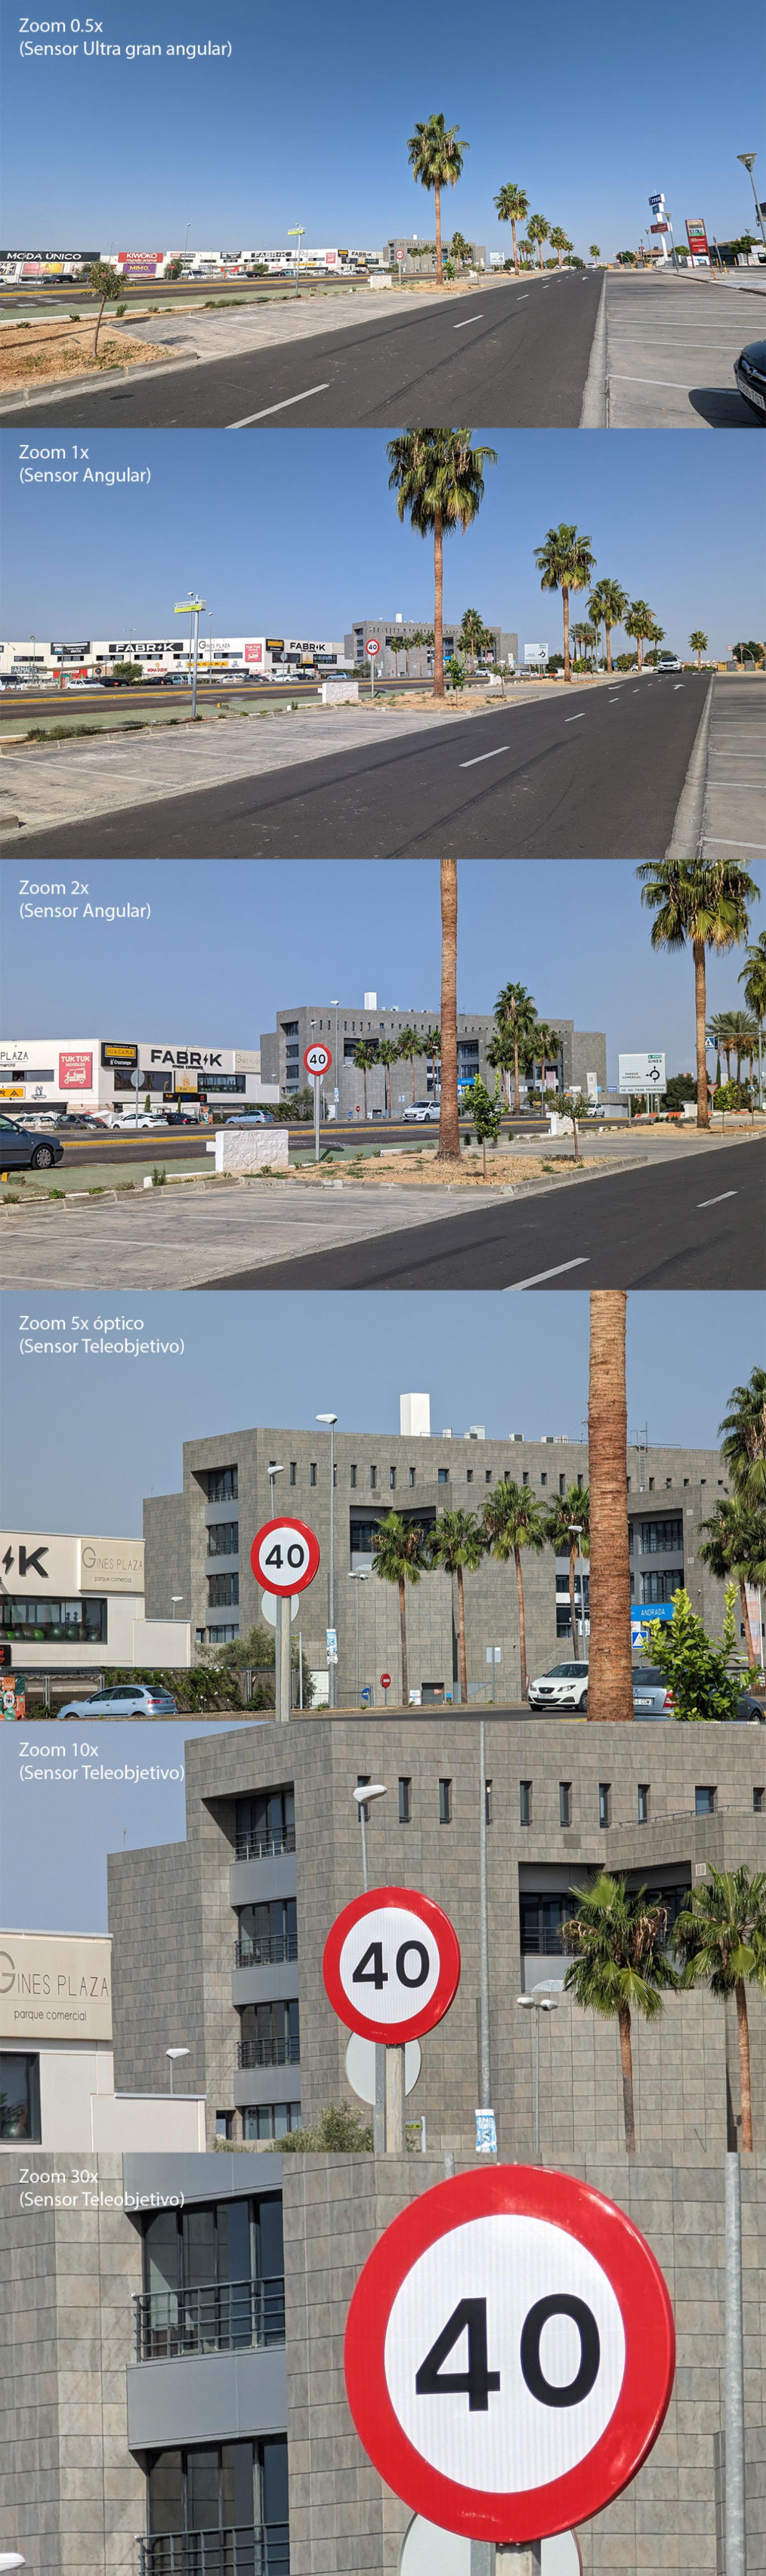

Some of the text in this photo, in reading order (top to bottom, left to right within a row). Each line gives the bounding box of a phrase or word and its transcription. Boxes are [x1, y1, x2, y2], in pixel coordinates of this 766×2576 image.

[0, 1052, 28, 1060] PLAZA
[309, 1054, 326, 1065] 40
[82, 1546, 144, 1571] GINES PLAZA
[265, 1544, 304, 1569] 40
[641, 1608, 665, 1616] ANDRADA
[352, 1940, 430, 1990] 40
[57, 1976, 109, 1997] PLAZA
[14, 2010, 87, 2021] parque comercial
[415, 2293, 600, 2412] 40
